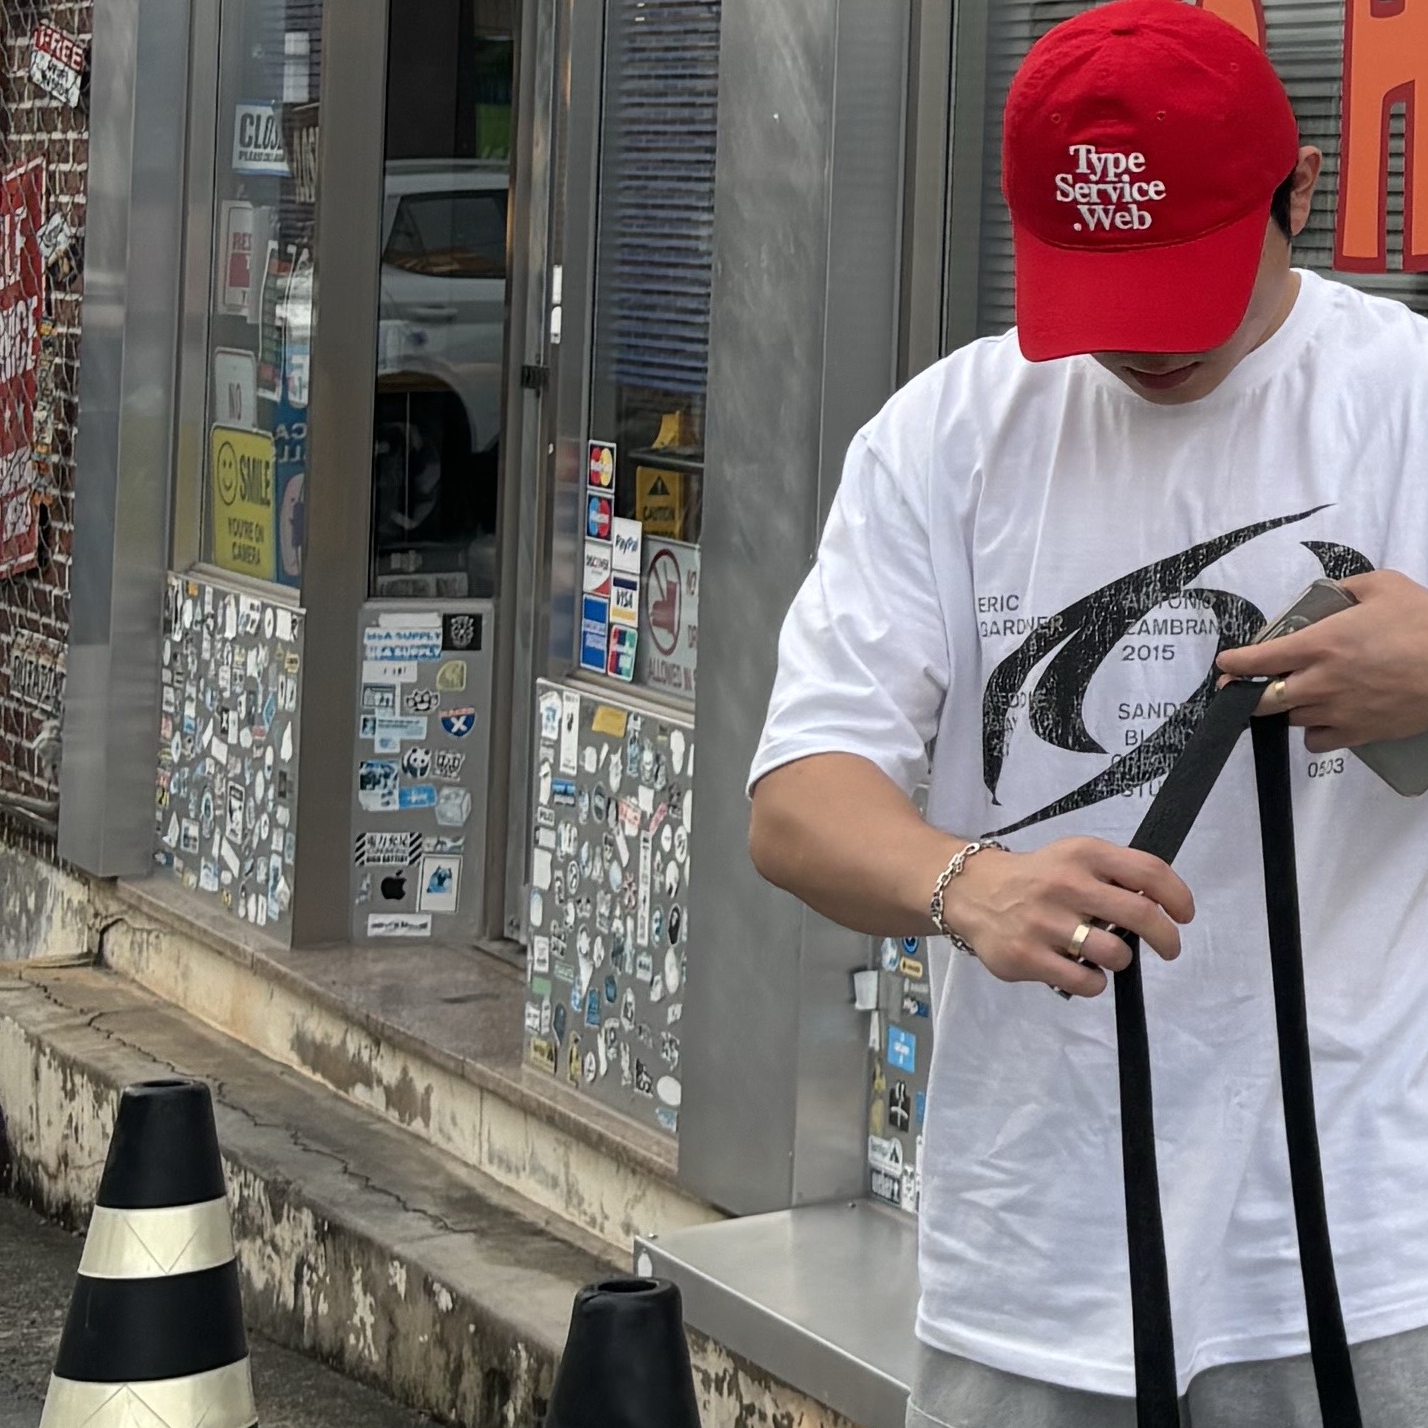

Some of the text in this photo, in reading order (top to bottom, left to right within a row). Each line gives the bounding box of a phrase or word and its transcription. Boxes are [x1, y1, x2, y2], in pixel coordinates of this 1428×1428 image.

[1069, 144, 1146, 182] Type
[1055, 174, 1166, 203] Service
[1073, 204, 1152, 231] .Web
[239, 454, 271, 507] SMILE
[615, 535, 638, 555] PayPal
[616, 589, 634, 609] VISA
[978, 594, 1020, 613] ERIC
[1121, 644, 1175, 662] 2015
[1121, 779, 1161, 798] STU
